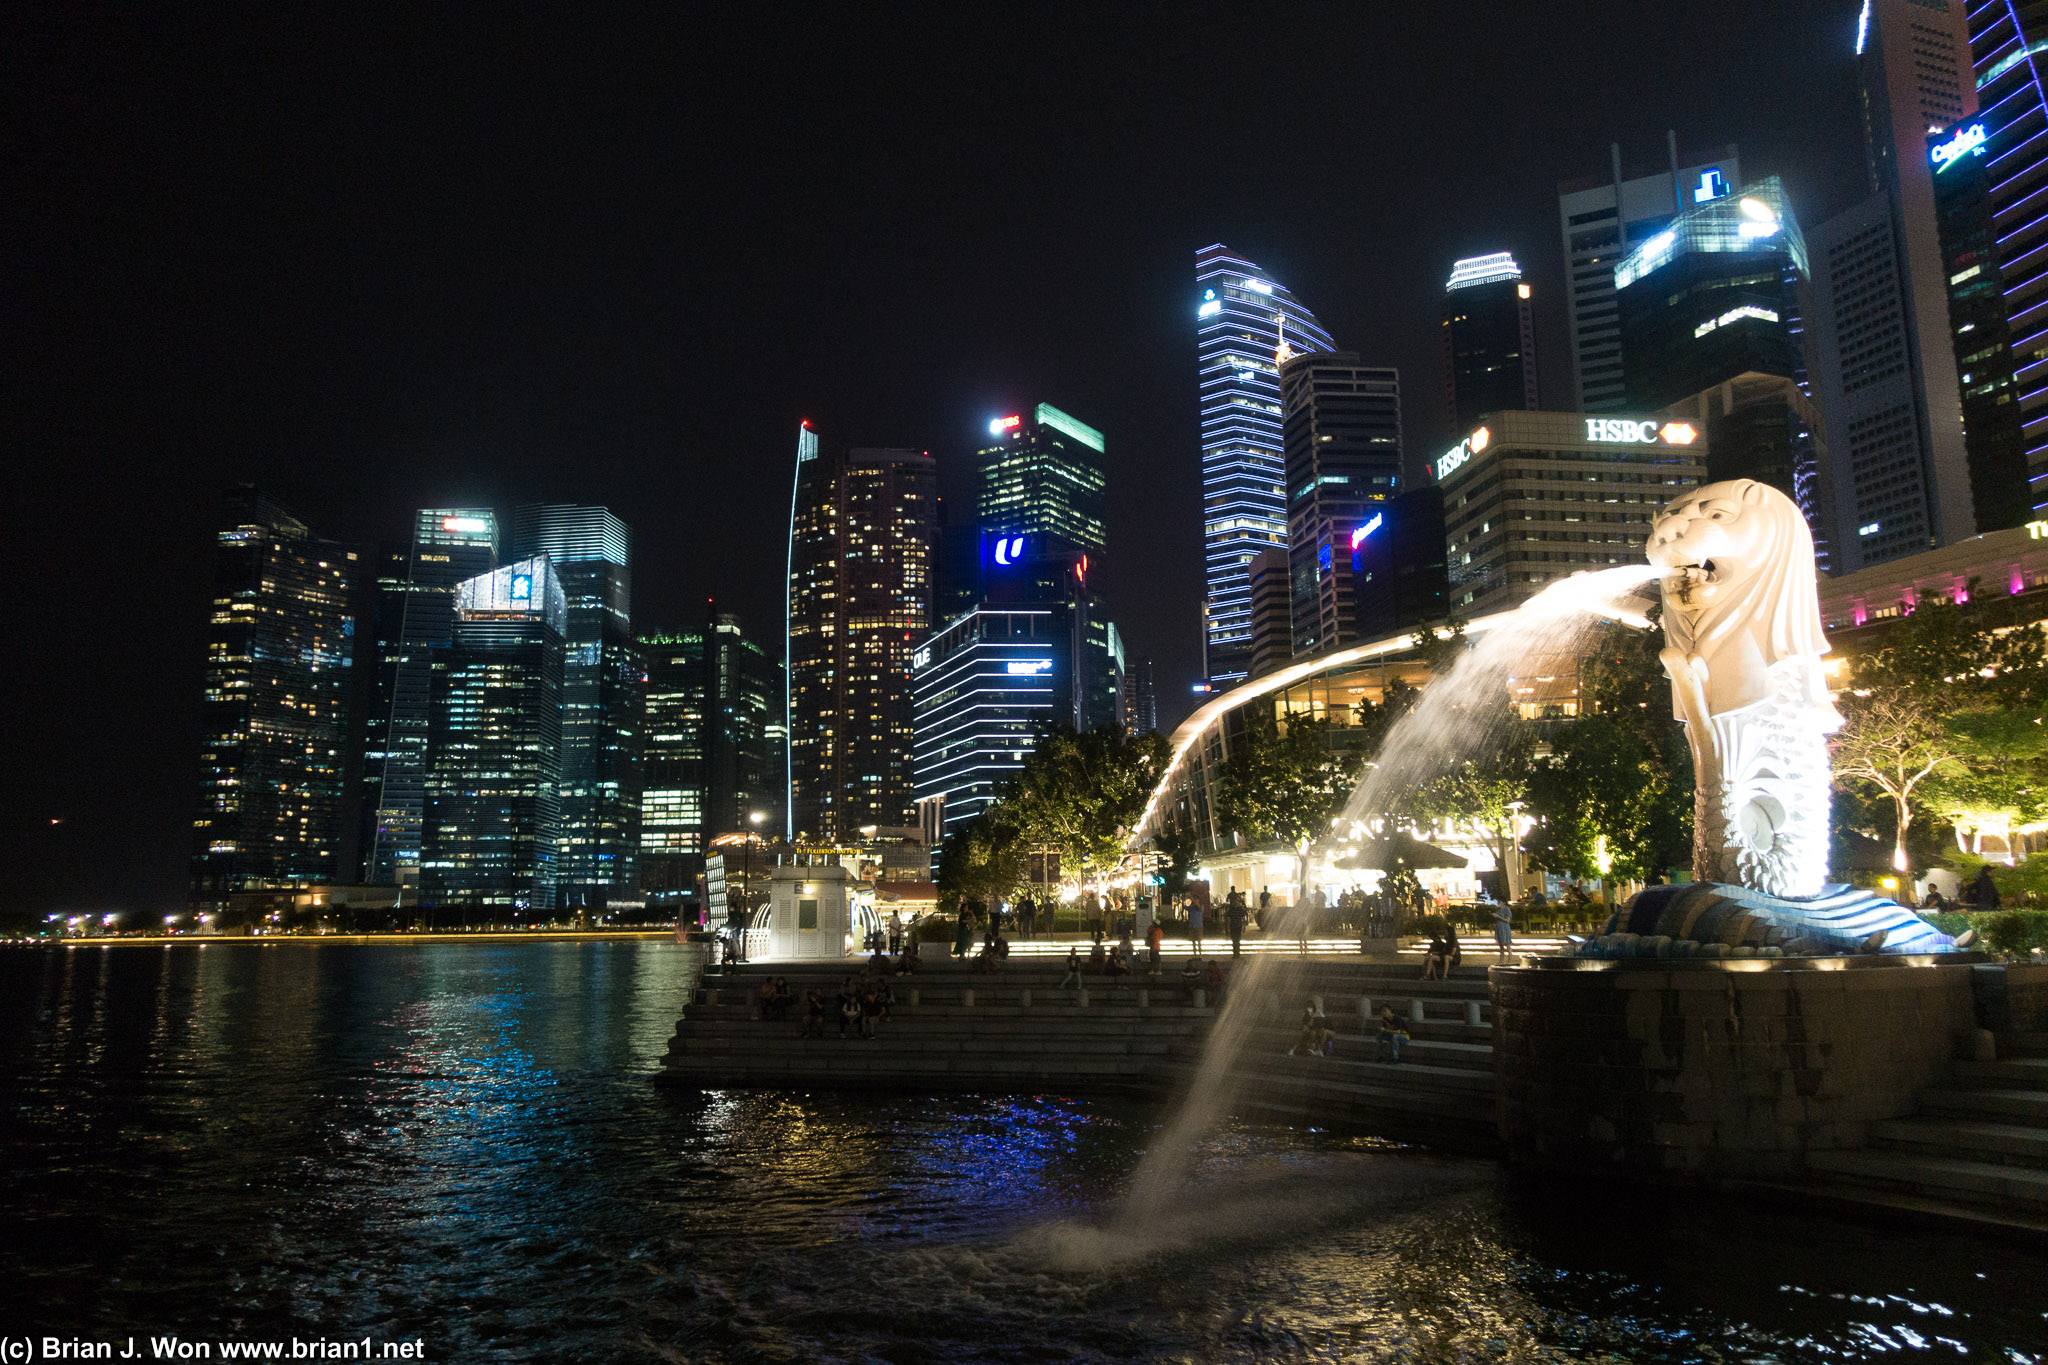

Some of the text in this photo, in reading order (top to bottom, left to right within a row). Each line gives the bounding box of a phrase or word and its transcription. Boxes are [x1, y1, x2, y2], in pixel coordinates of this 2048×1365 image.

[1001, 416, 1020, 429] UBS
[1585, 419, 1658, 444] HSBC
[1437, 438, 1471, 481] HSBC
[913, 648, 931, 669] OUE
[807, 847, 836, 855] FULLERTON
